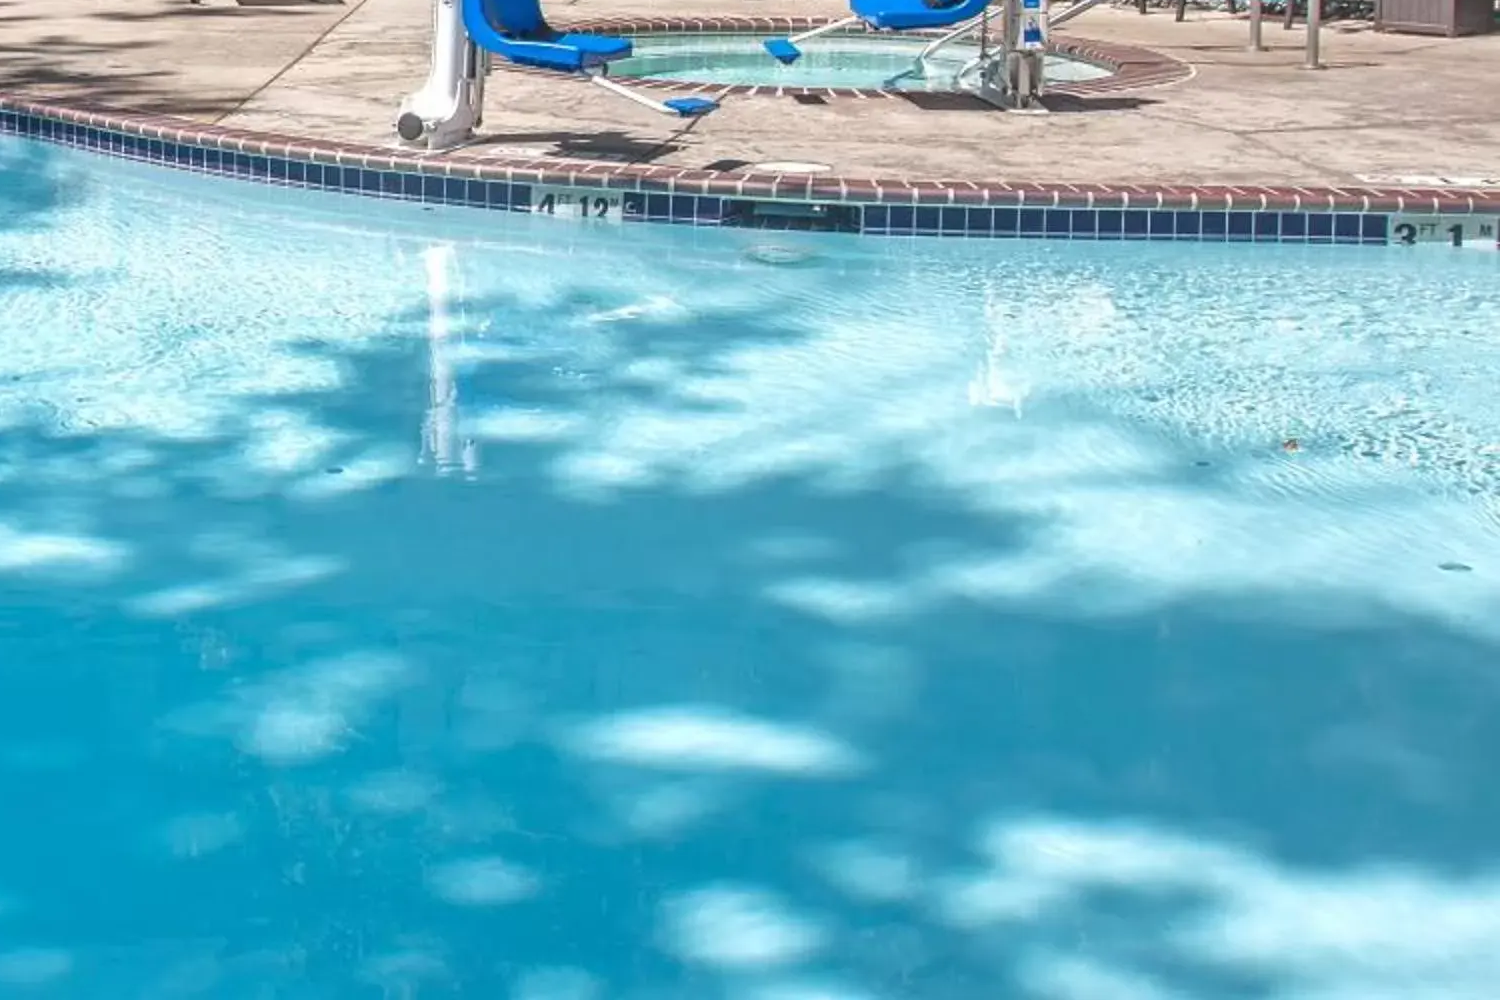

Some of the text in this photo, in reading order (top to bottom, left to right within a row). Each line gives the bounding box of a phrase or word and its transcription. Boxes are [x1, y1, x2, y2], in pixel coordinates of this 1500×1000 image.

[539, 194, 555, 215] 4
[1394, 223, 1493, 247] 3 FT 1 M
